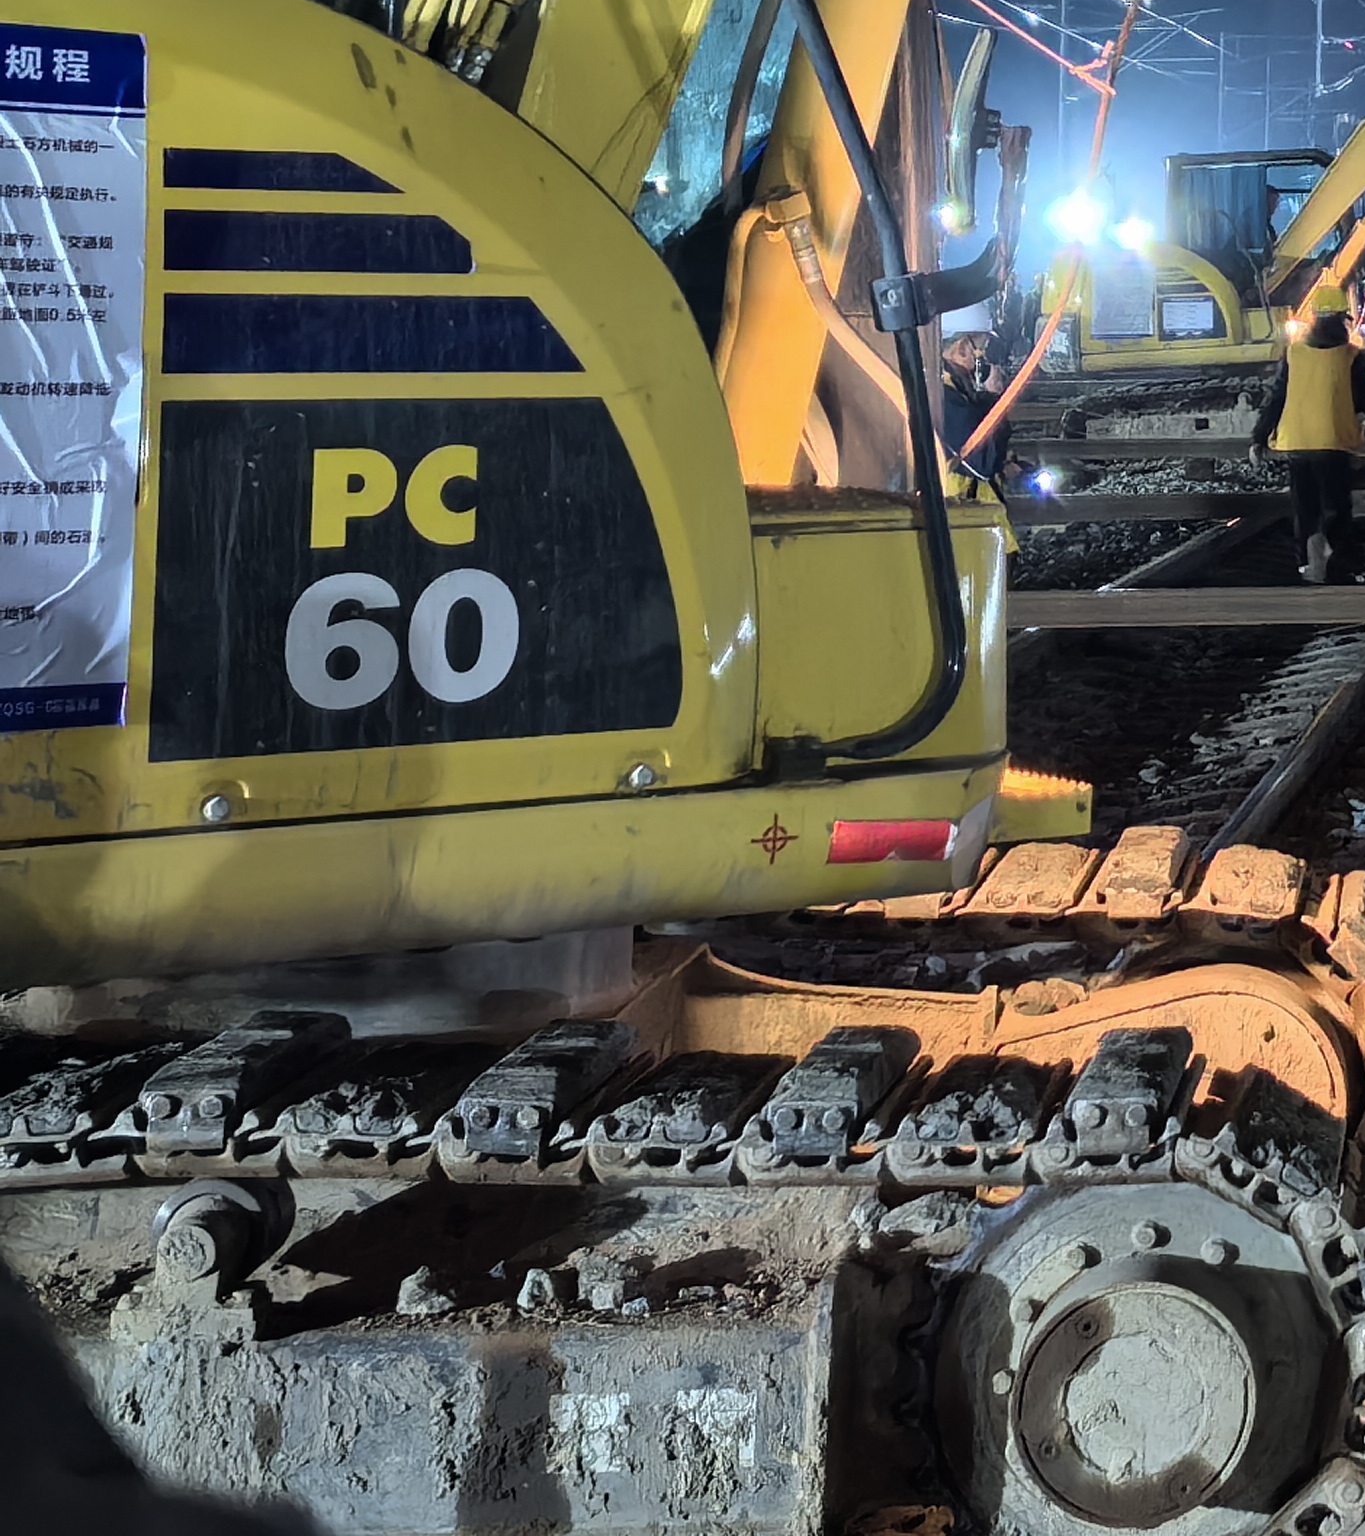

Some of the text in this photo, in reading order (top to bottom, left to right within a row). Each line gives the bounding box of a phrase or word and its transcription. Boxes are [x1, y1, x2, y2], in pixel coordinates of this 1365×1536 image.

[5, 44, 91, 83] 规程
[0, 184, 117, 201] 的有关规定执行。
[309, 444, 480, 550] PC
[284, 568, 520, 711] 60
